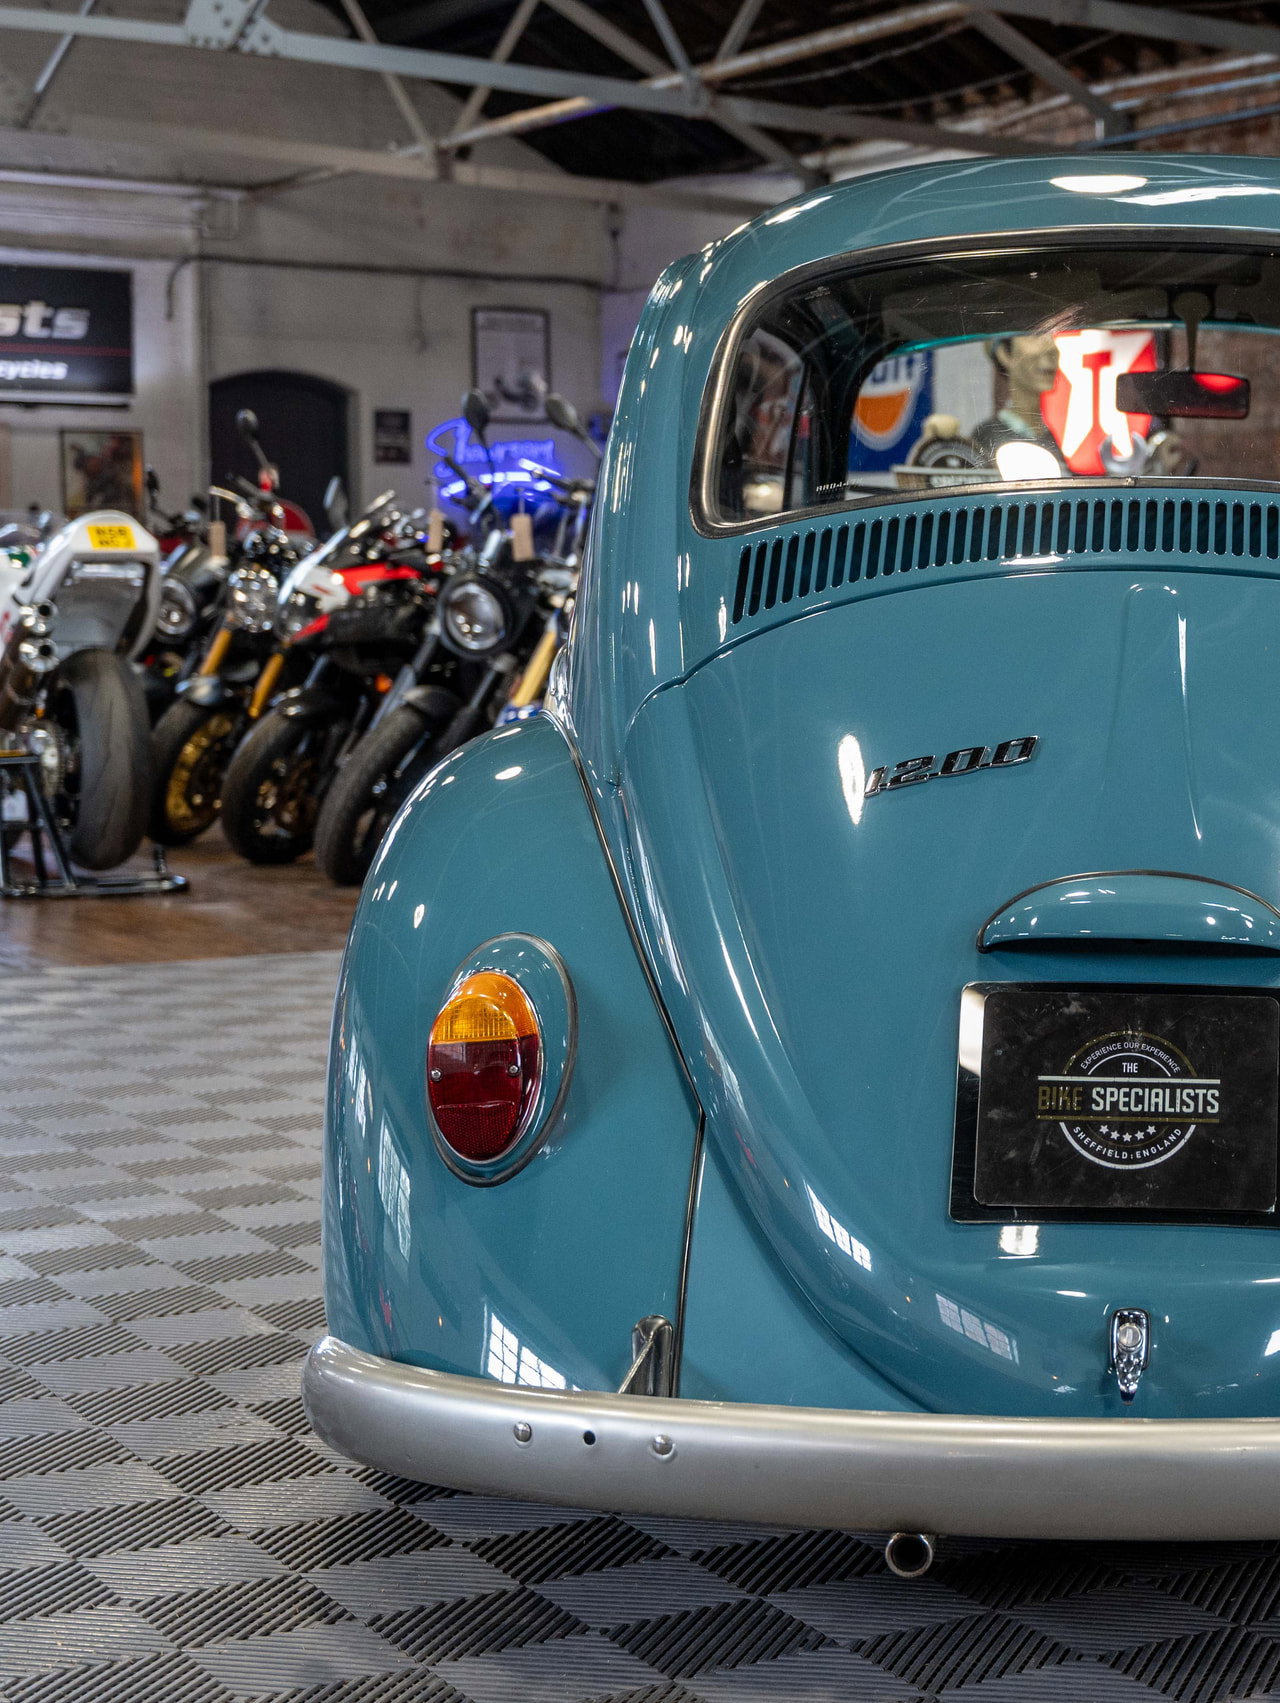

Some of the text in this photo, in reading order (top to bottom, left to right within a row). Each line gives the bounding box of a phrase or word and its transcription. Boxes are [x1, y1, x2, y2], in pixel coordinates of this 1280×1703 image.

[864, 735, 1041, 798] 1200
[1080, 1042, 1122, 1070] EXPERIENCE
[1141, 1043, 1181, 1073] EXPERIENCE
[1122, 1062, 1139, 1073] THE
[1037, 1086, 1220, 1113] BIKE SPECIALISTS
